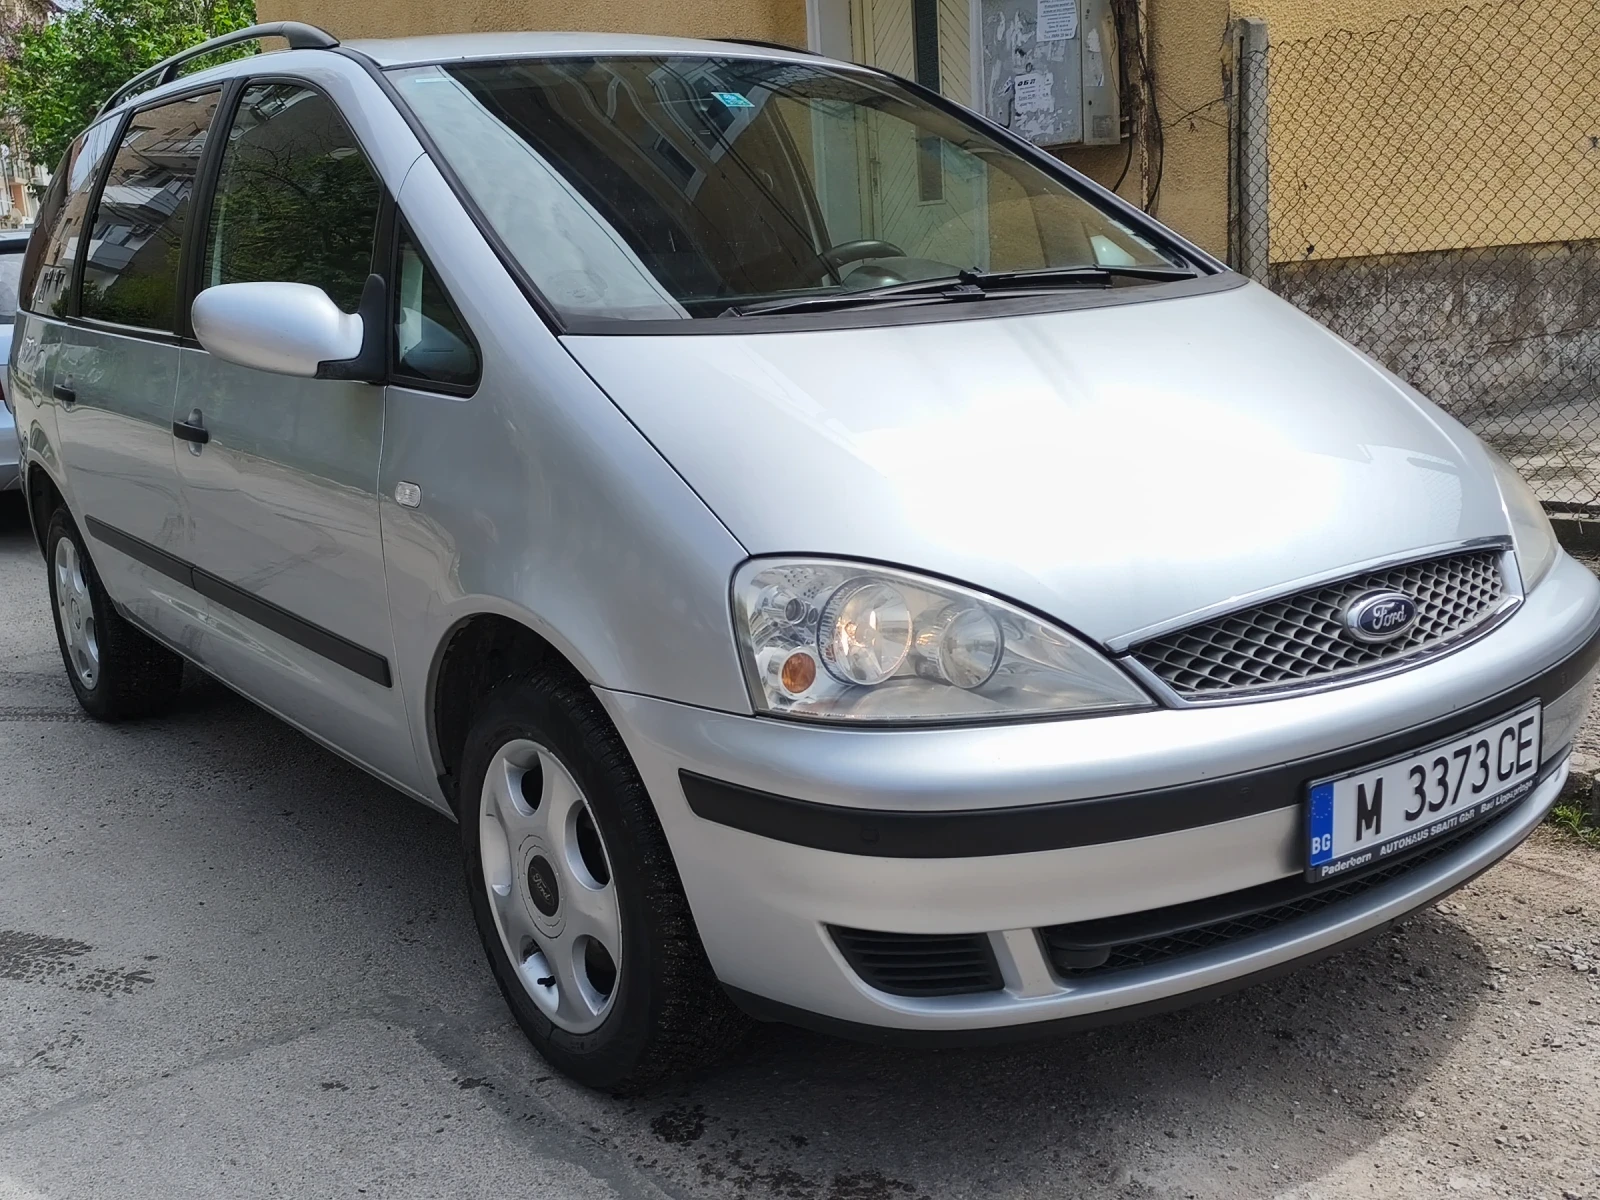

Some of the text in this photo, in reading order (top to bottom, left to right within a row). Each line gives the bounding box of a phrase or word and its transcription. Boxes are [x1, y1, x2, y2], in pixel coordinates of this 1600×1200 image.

[1372, 601, 1407, 630] Ford
[1355, 777, 1383, 842] M
[1312, 833, 1331, 855] BG
[1321, 852, 1372, 877] Paderborn
[1379, 829, 1429, 856] AUTOHAUS
[1459, 808, 1475, 823] GbR
[1480, 798, 1495, 813] Bad
[533, 873, 551, 901] Ford
